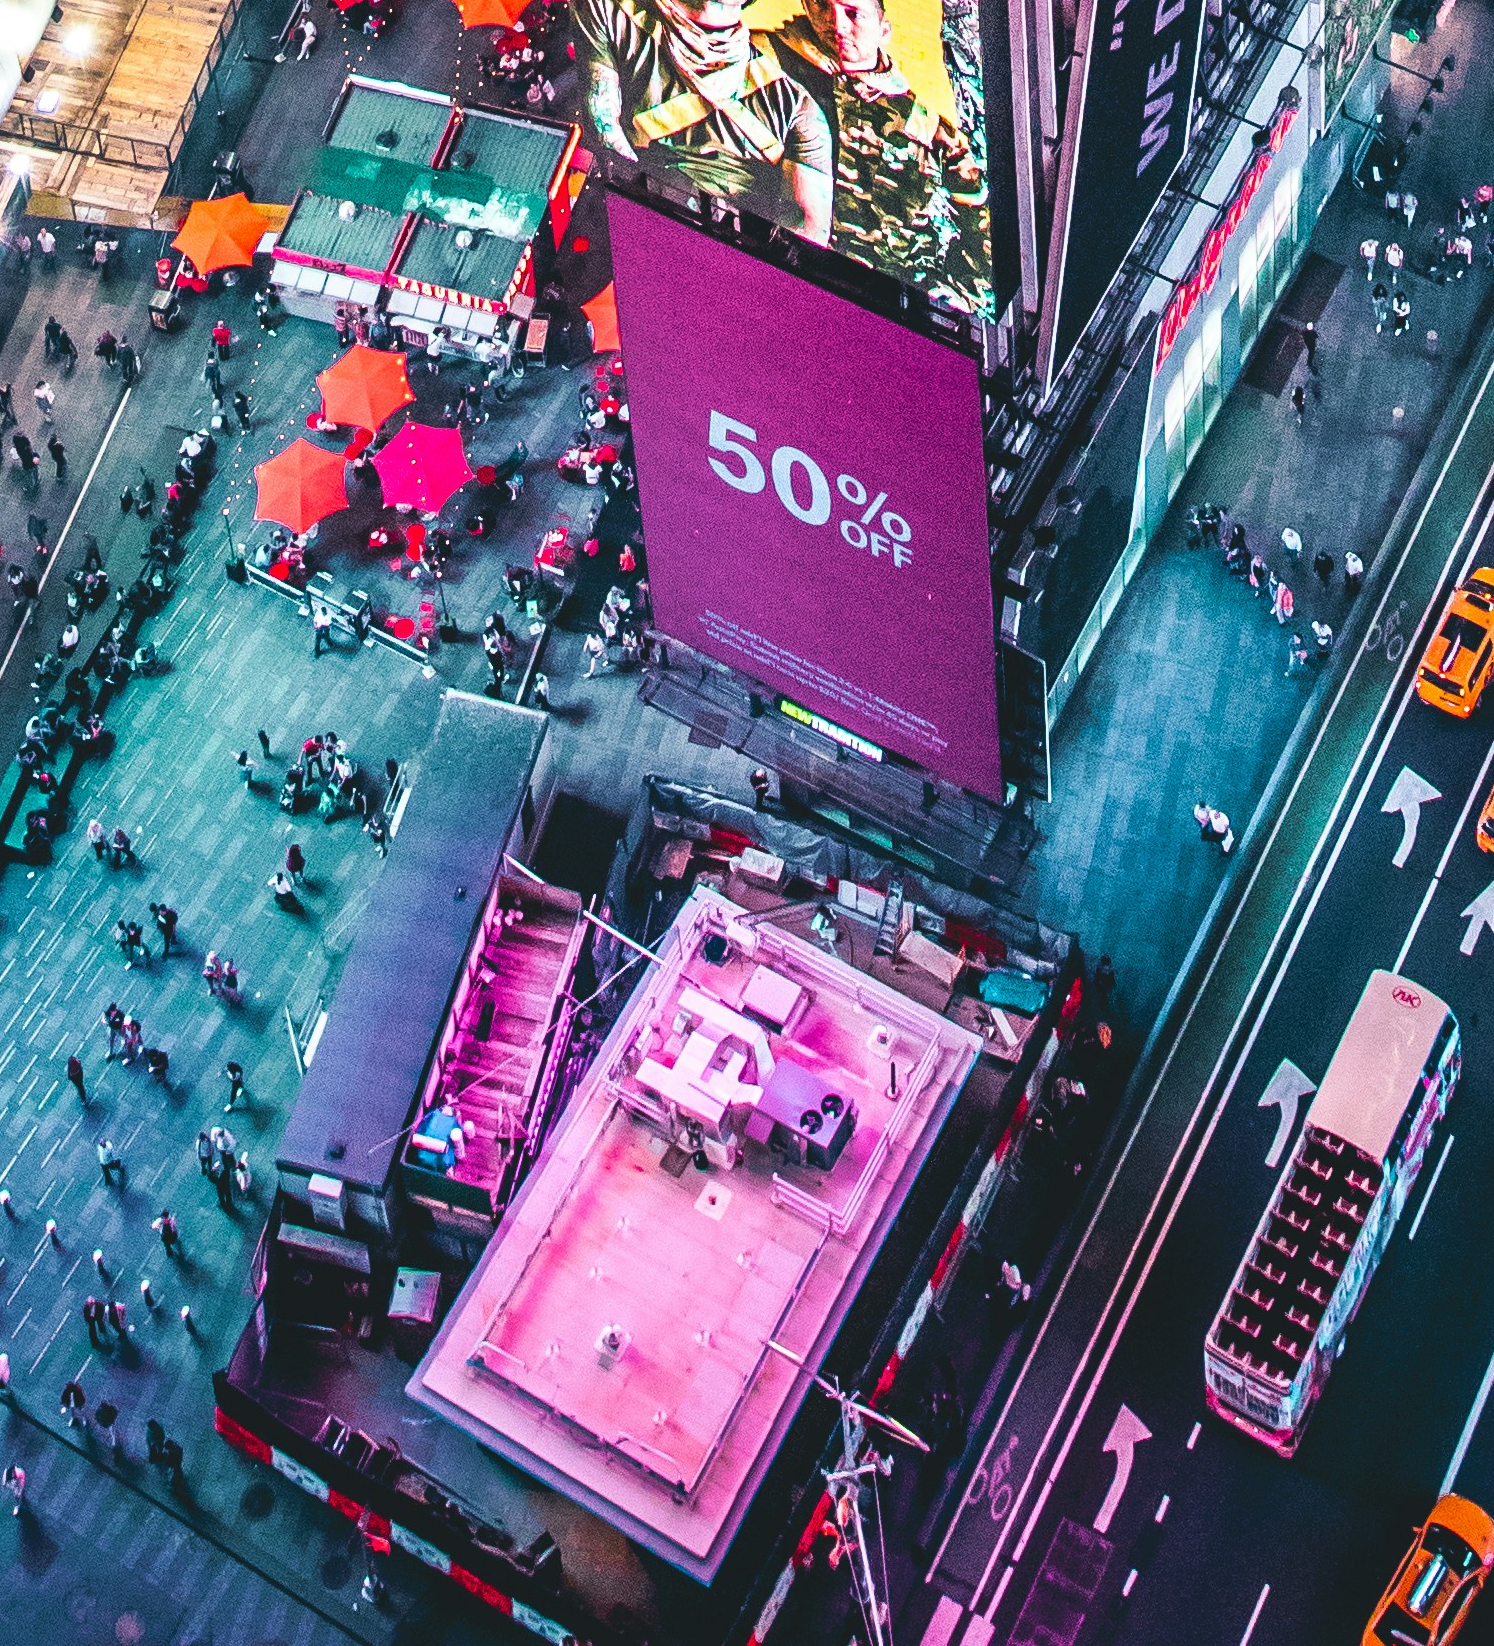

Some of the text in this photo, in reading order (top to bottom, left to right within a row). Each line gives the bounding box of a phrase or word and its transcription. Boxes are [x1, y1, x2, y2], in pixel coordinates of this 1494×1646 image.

[1137, 52, 1180, 177] WE
[708, 409, 913, 543] 50%
[840, 520, 913, 570] OFF
